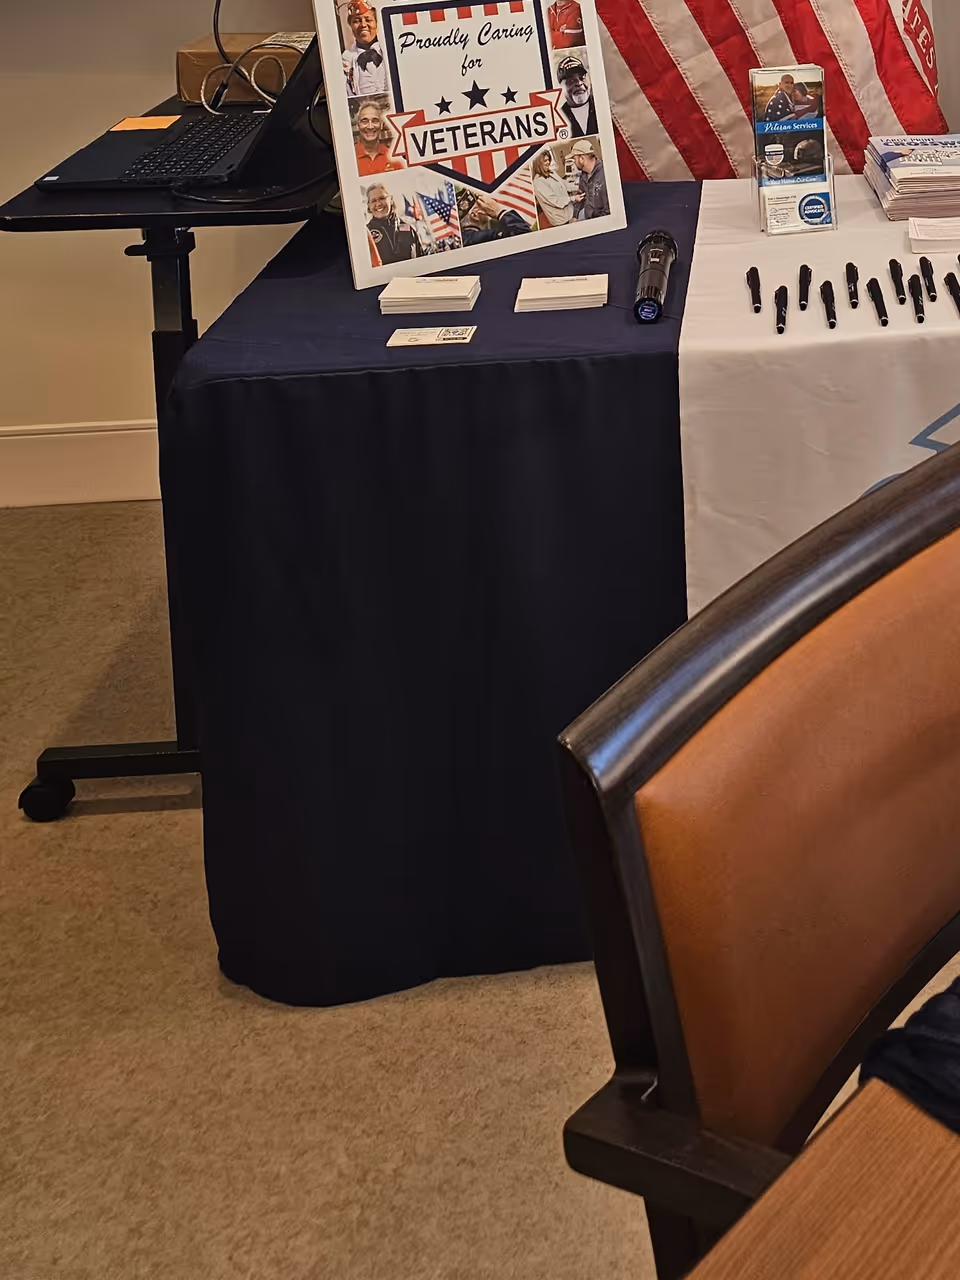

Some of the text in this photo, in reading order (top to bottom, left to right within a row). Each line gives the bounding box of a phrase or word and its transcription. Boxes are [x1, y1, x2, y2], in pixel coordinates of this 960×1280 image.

[398, 21, 535, 54] Proudly Caring
[461, 54, 483, 76] for
[410, 111, 549, 157] VETERANS
[764, 121, 818, 132] Veteran Services
